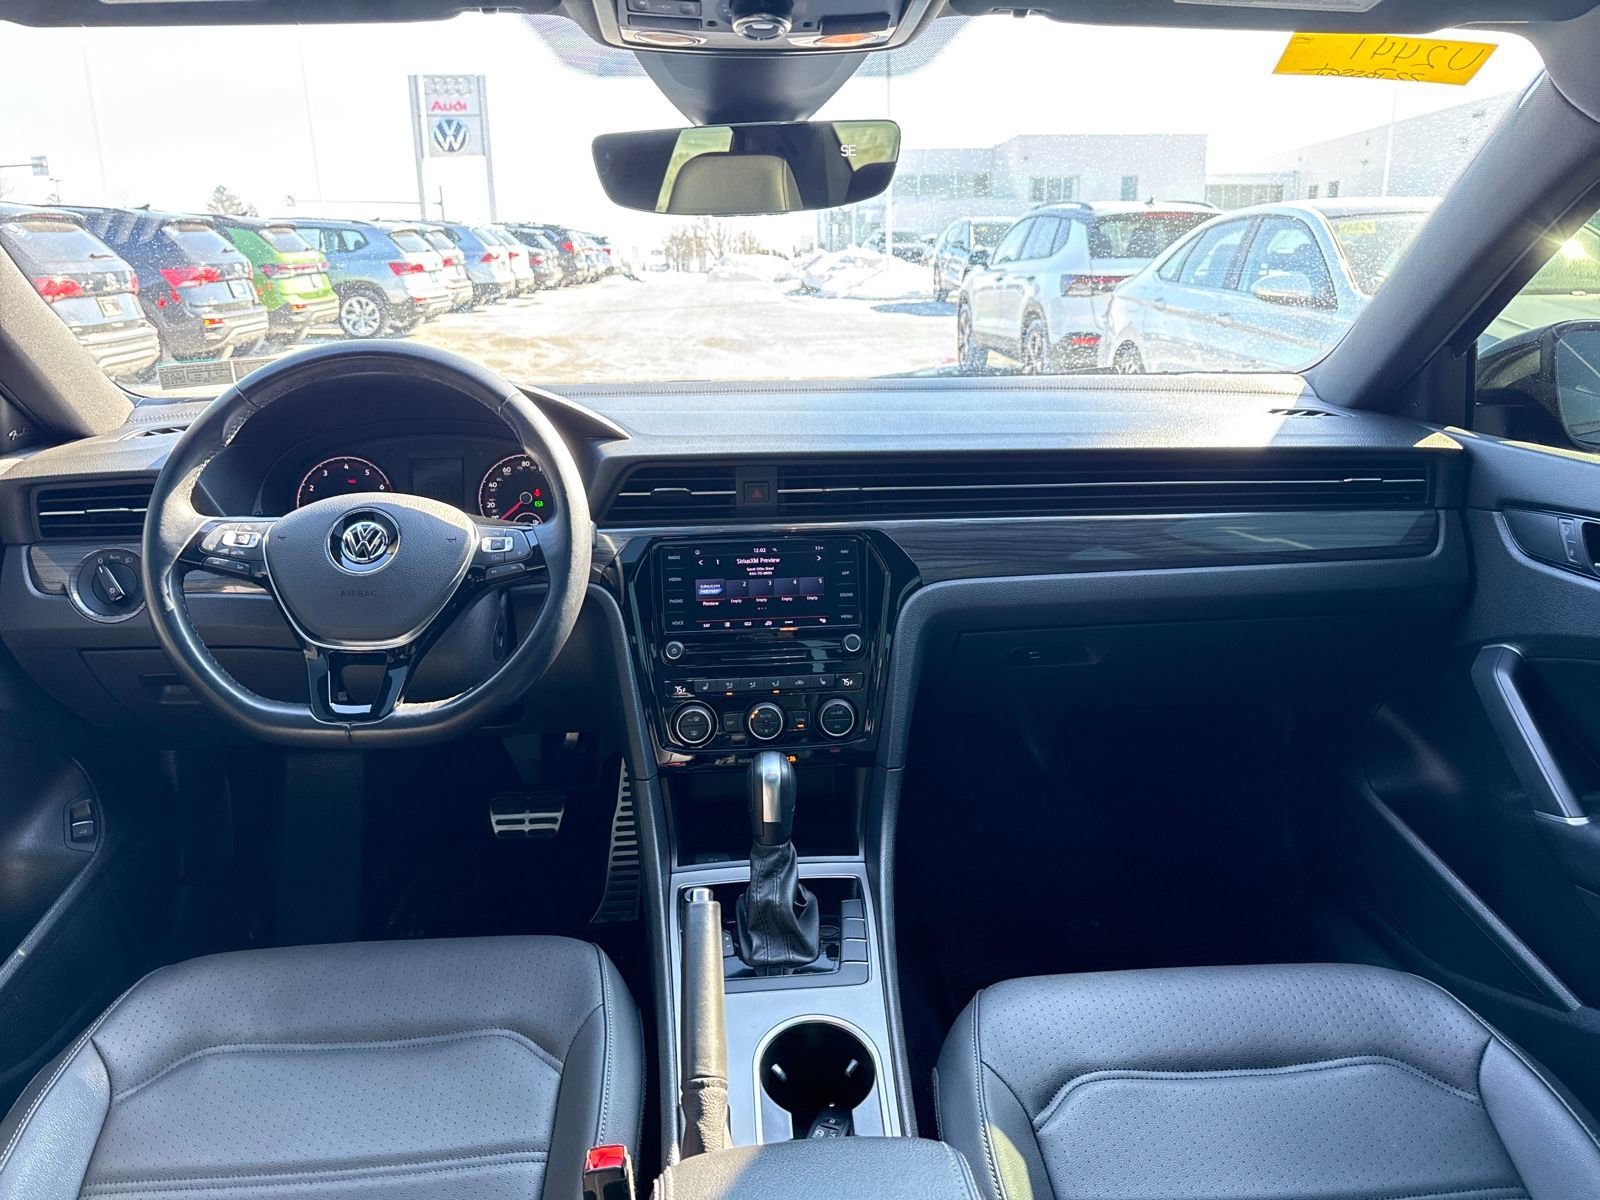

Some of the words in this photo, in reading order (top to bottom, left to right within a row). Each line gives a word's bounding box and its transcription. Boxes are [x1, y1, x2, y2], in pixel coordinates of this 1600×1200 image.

[431, 100, 468, 112] Audi
[840, 144, 857, 157] SE
[322, 469, 328, 477] 3
[308, 484, 315, 492] 2
[760, 556, 780, 564] Preview
[340, 590, 378, 598] AIRBAG
